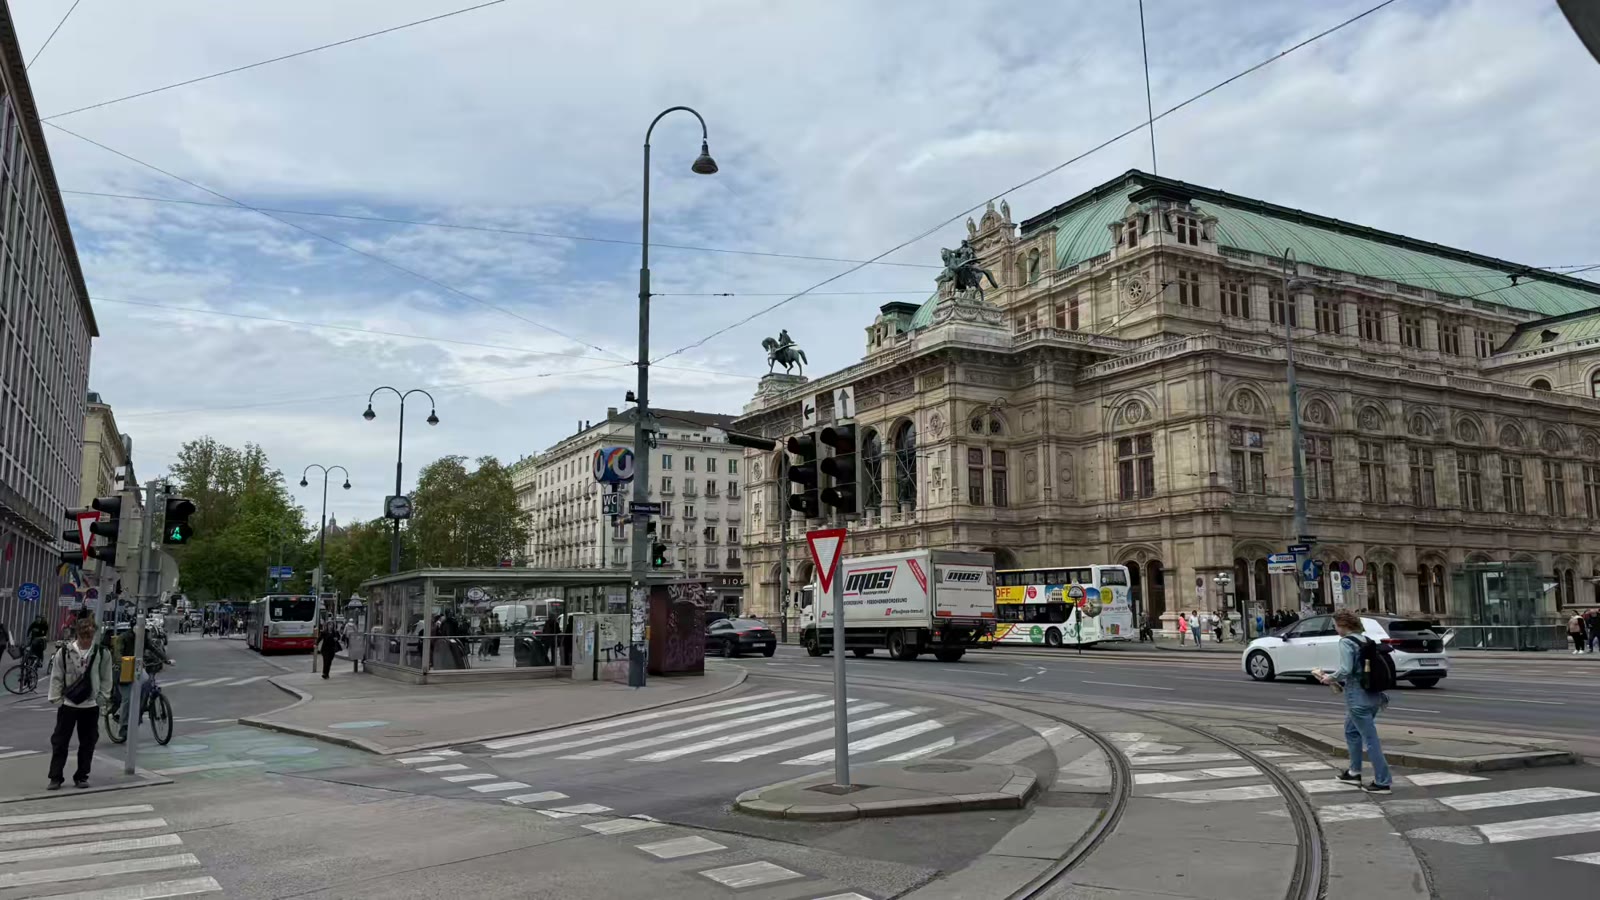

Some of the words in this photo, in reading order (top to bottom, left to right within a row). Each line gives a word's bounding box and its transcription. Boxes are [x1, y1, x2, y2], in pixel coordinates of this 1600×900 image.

[613, 455, 632, 479] U
[603, 494, 617, 505] WC
[995, 588, 1011, 597] OFF
